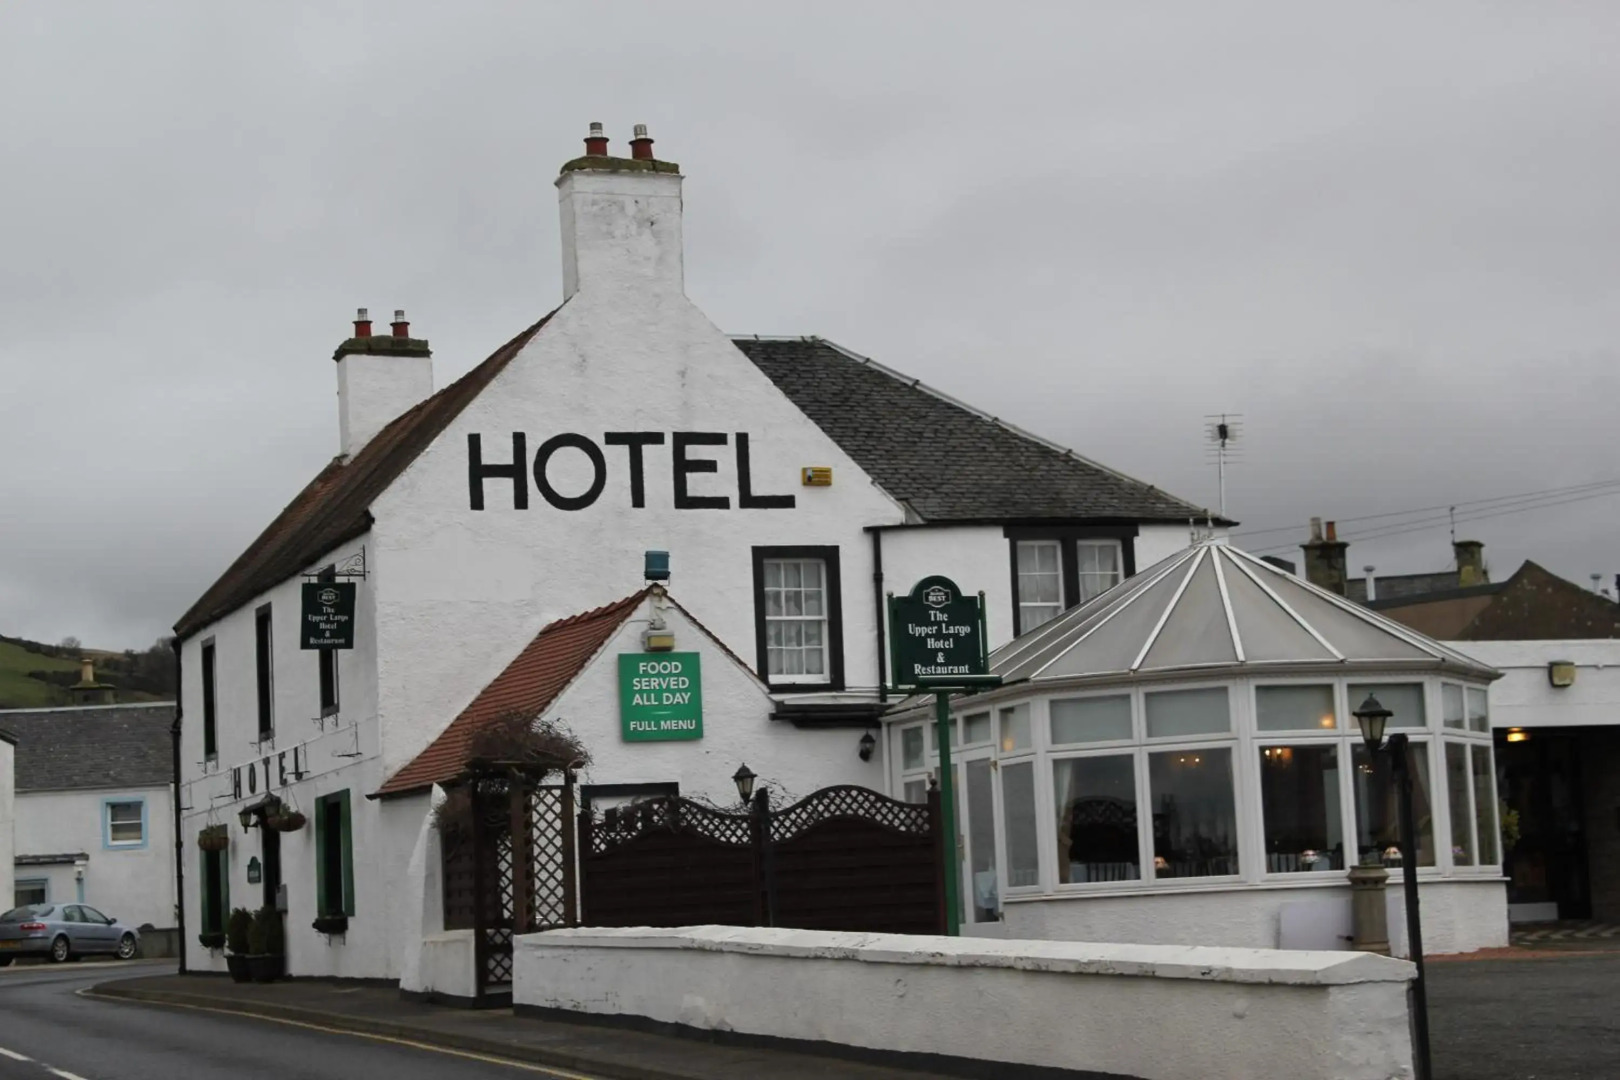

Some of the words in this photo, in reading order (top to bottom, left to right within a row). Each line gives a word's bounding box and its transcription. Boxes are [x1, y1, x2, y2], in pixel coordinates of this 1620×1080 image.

[468, 432, 796, 511] HOTEL
[929, 610, 949, 621] The
[908, 623, 938, 637] Upper
[942, 623, 971, 637] Largo
[926, 637, 954, 649] Hotel
[936, 652, 946, 663] &
[639, 661, 682, 674] FOOD
[914, 663, 970, 675] Restaurant
[632, 677, 690, 690] SERVED
[632, 693, 659, 705] ALL
[662, 692, 692, 705] DAY
[630, 721, 658, 731] FULL
[660, 720, 696, 730] MENU
[233, 747, 304, 799] HOTEL
